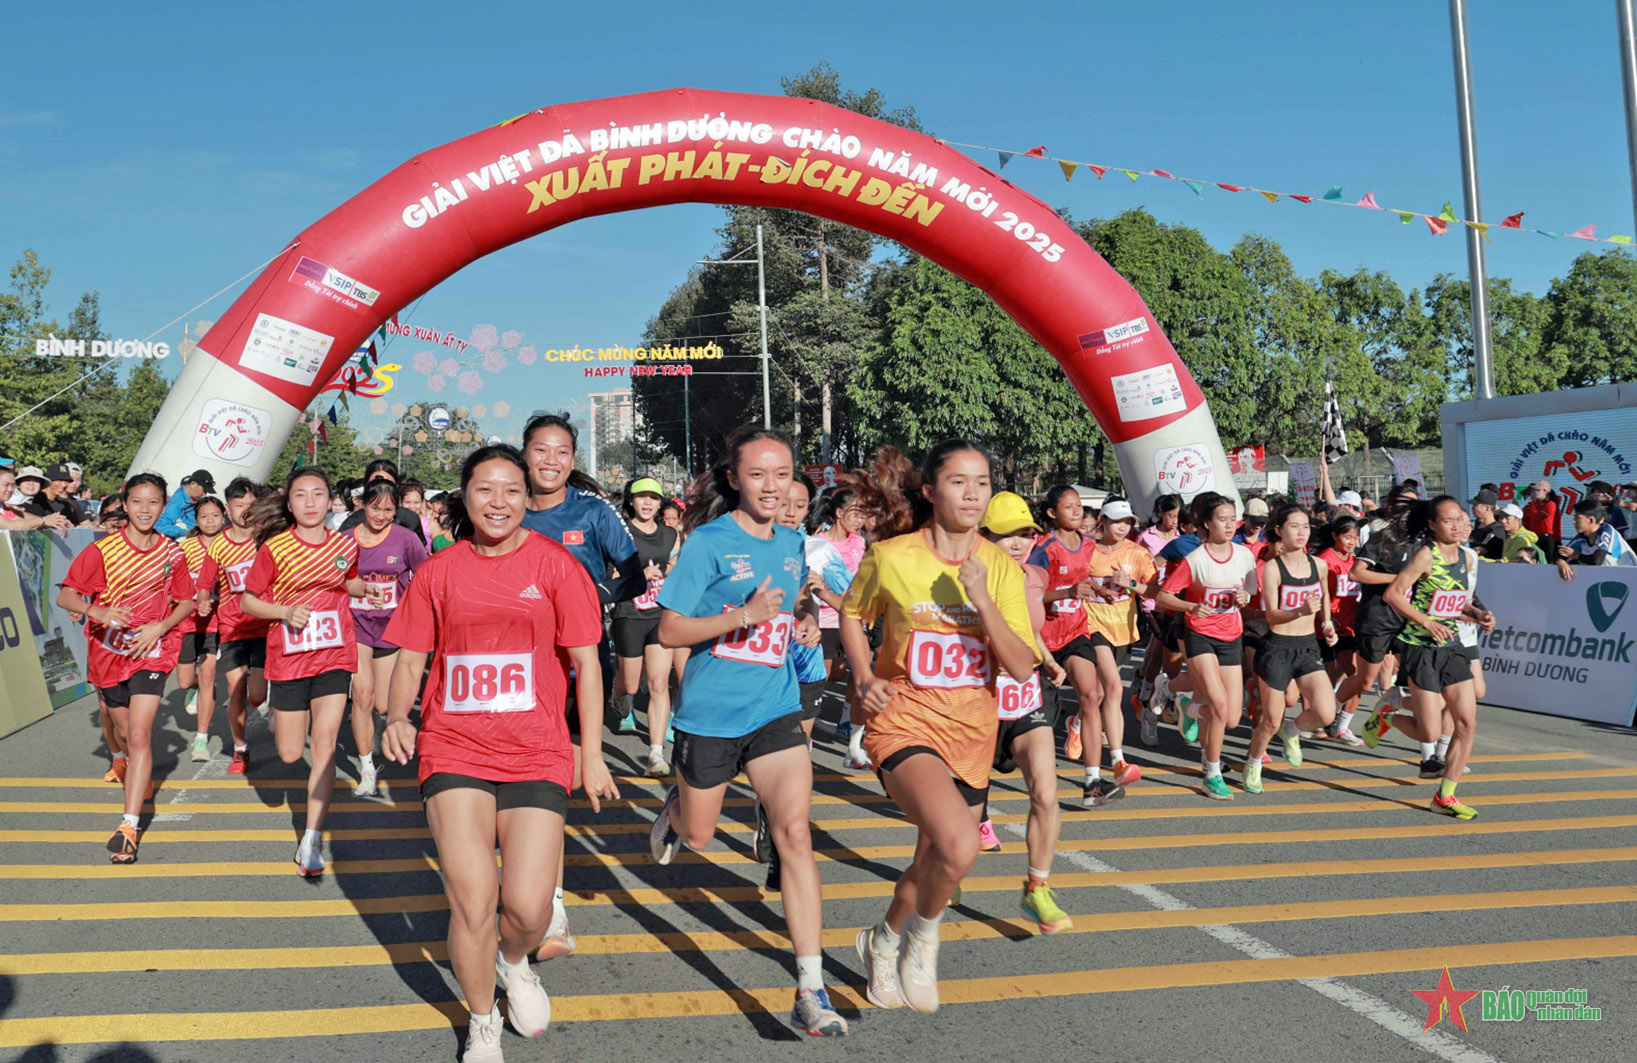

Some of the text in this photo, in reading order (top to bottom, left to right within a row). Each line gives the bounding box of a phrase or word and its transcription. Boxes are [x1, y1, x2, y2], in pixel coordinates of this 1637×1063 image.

[402, 181, 469, 229] GIẢI
[466, 148, 534, 192] VIỆT
[538, 129, 586, 165] DÃ
[590, 120, 663, 153] BÌNH
[782, 127, 862, 159] CHÀO
[867, 149, 939, 188] NĂM
[940, 176, 1000, 218] MỚI
[993, 211, 1066, 263] 2025
[524, 149, 632, 214] XUẤT
[856, 179, 945, 227] ĐẾN
[35, 332, 171, 359] BÌNH DƯƠNG
[545, 343, 595, 363] CHÚC
[650, 343, 690, 361] NĂM
[689, 340, 724, 361] MỚI
[584, 364, 693, 378] HAPPY NEW YEAR
[199, 423, 222, 437] BTV
[1557, 429, 1590, 441] CHÀO
[1158, 471, 1176, 480] BTV
[519, 592, 543, 600] adidas
[912, 600, 946, 614] STOP
[1434, 594, 1467, 613] 092
[722, 619, 789, 657] 033
[1476, 627, 1636, 664] ietcombank
[917, 640, 988, 679] 032
[1482, 653, 1590, 684] BÌNH DƯƠNG
[450, 662, 526, 703] 086
